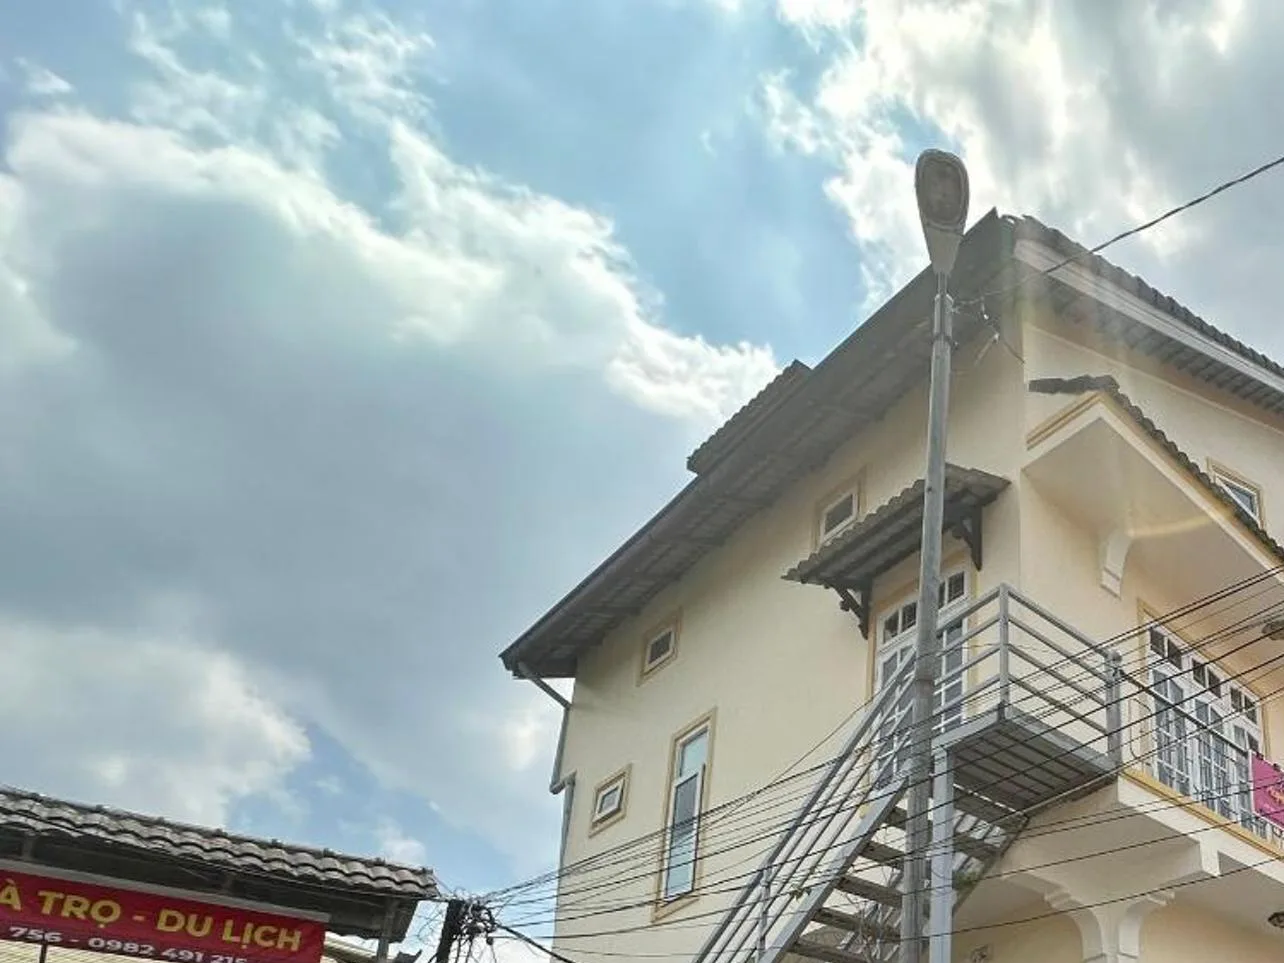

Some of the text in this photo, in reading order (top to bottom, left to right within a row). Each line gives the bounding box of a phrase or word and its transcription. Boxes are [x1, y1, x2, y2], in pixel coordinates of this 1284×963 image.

[37, 890, 121, 928] TRỌ
[157, 909, 212, 937] DU
[222, 919, 302, 950] LỊCH
[8, 926, 62, 943] 756
[88, 937, 154, 955] 0982
[161, 948, 203, 963] 491
